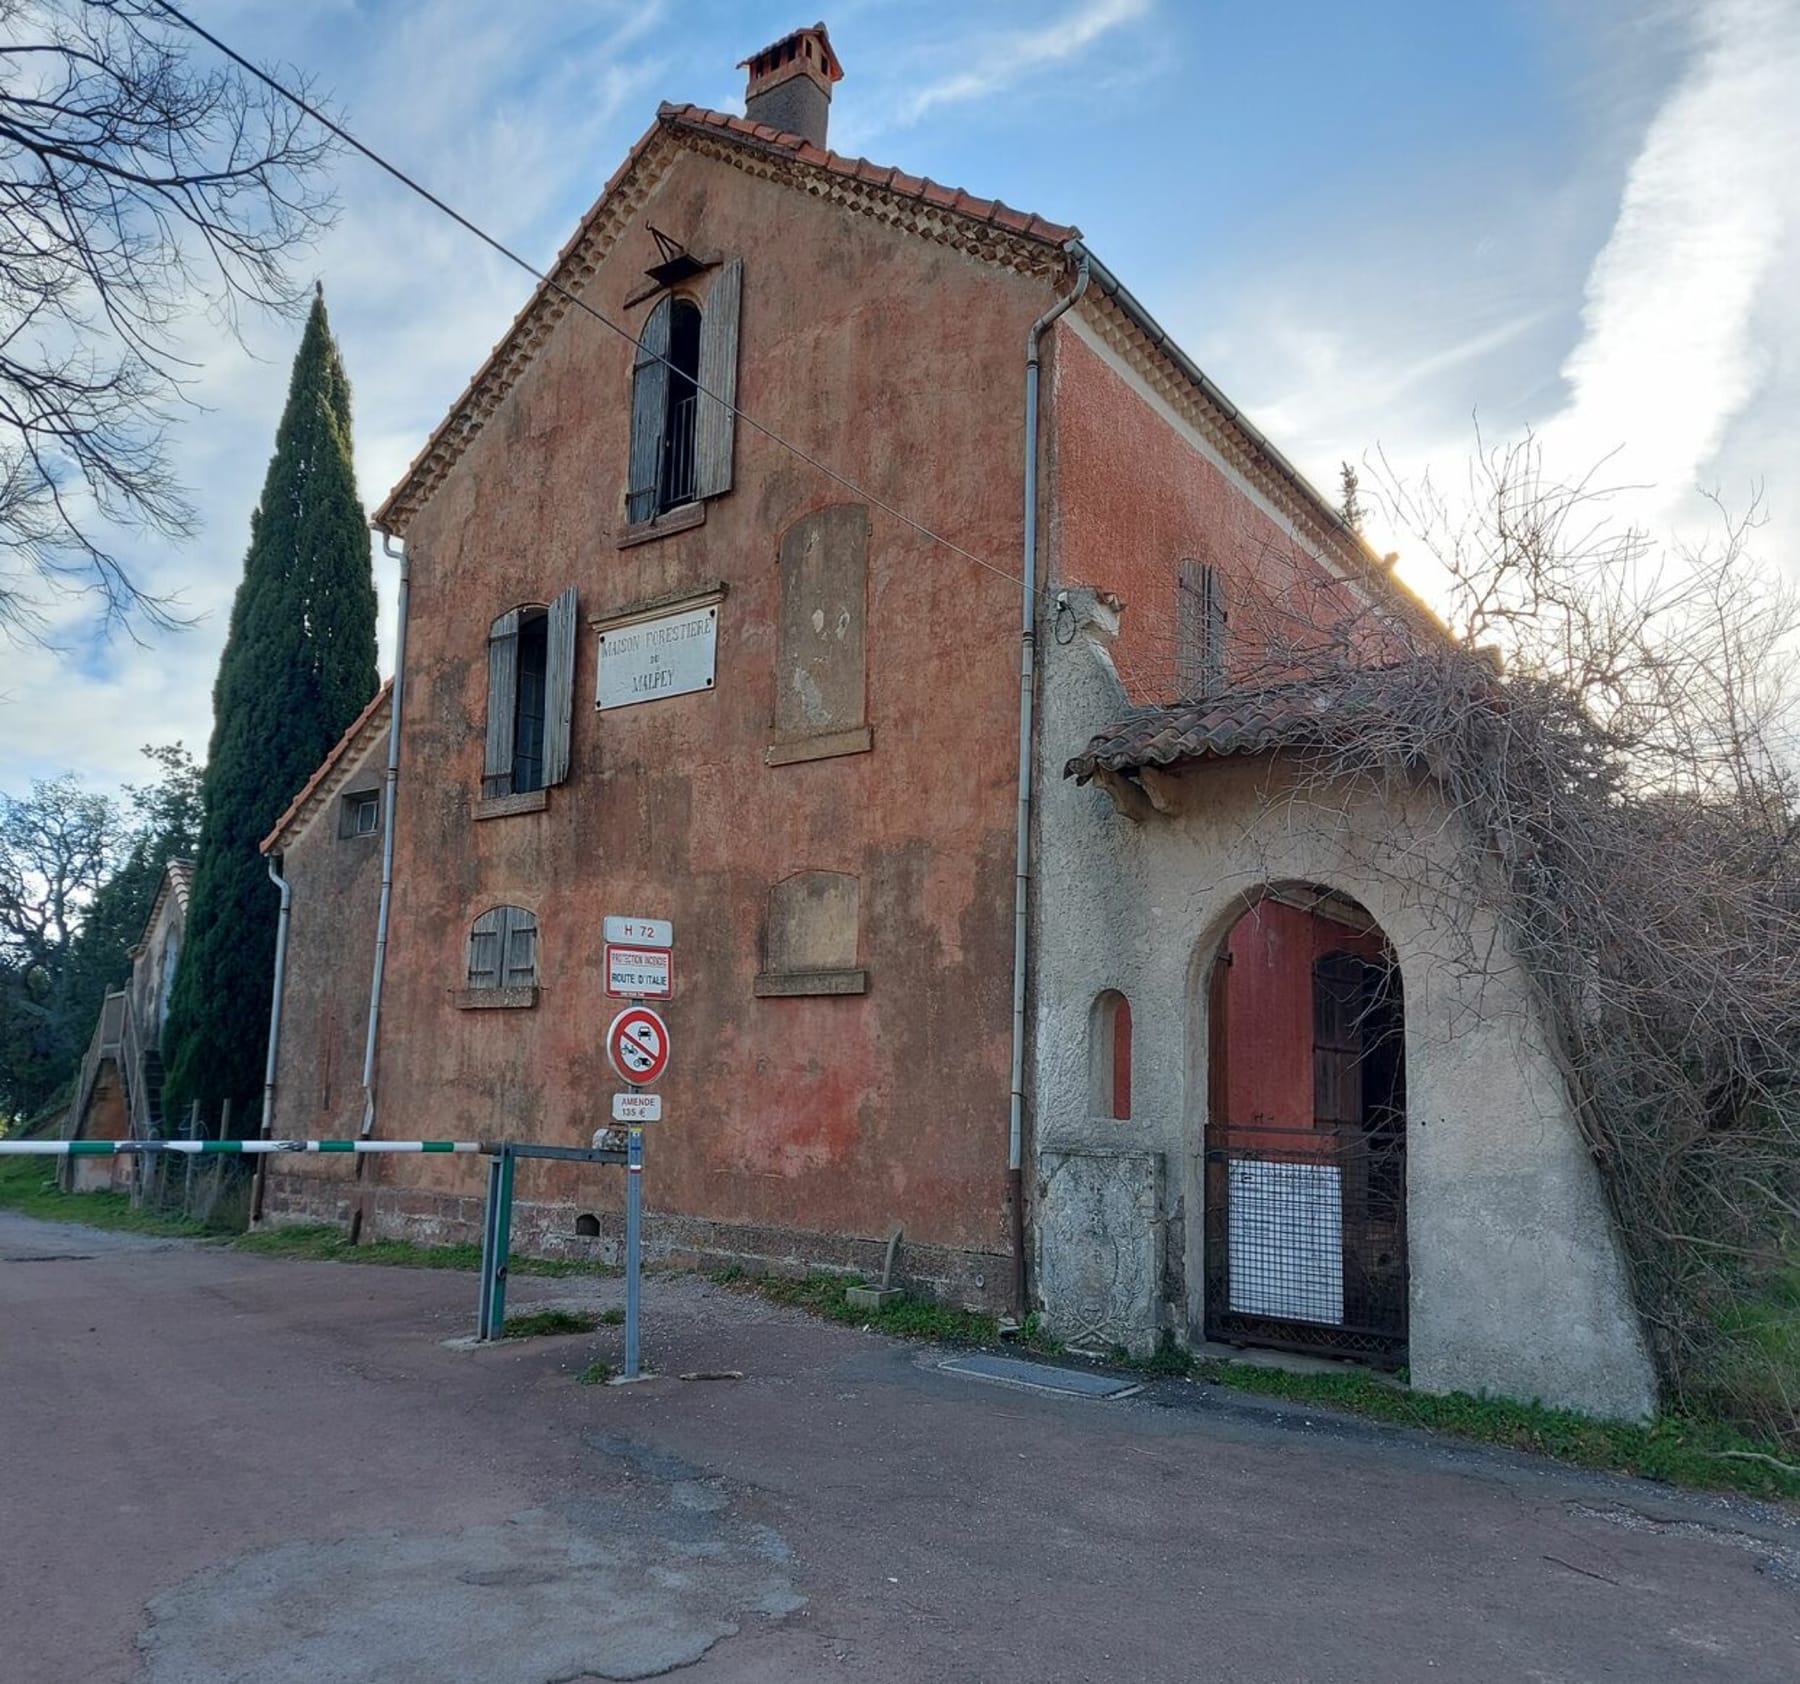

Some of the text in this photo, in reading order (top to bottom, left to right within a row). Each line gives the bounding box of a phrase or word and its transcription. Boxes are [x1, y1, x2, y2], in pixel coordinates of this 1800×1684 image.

[601, 634, 641, 658] MAISON
[632, 668, 674, 693] MALPEY
[624, 924, 655, 938] H 72
[612, 952, 643, 965] PROTECTION
[612, 973, 636, 985] ROUTE
[621, 1096, 656, 1107] AMENDE
[622, 1107, 648, 1118] 135 €
